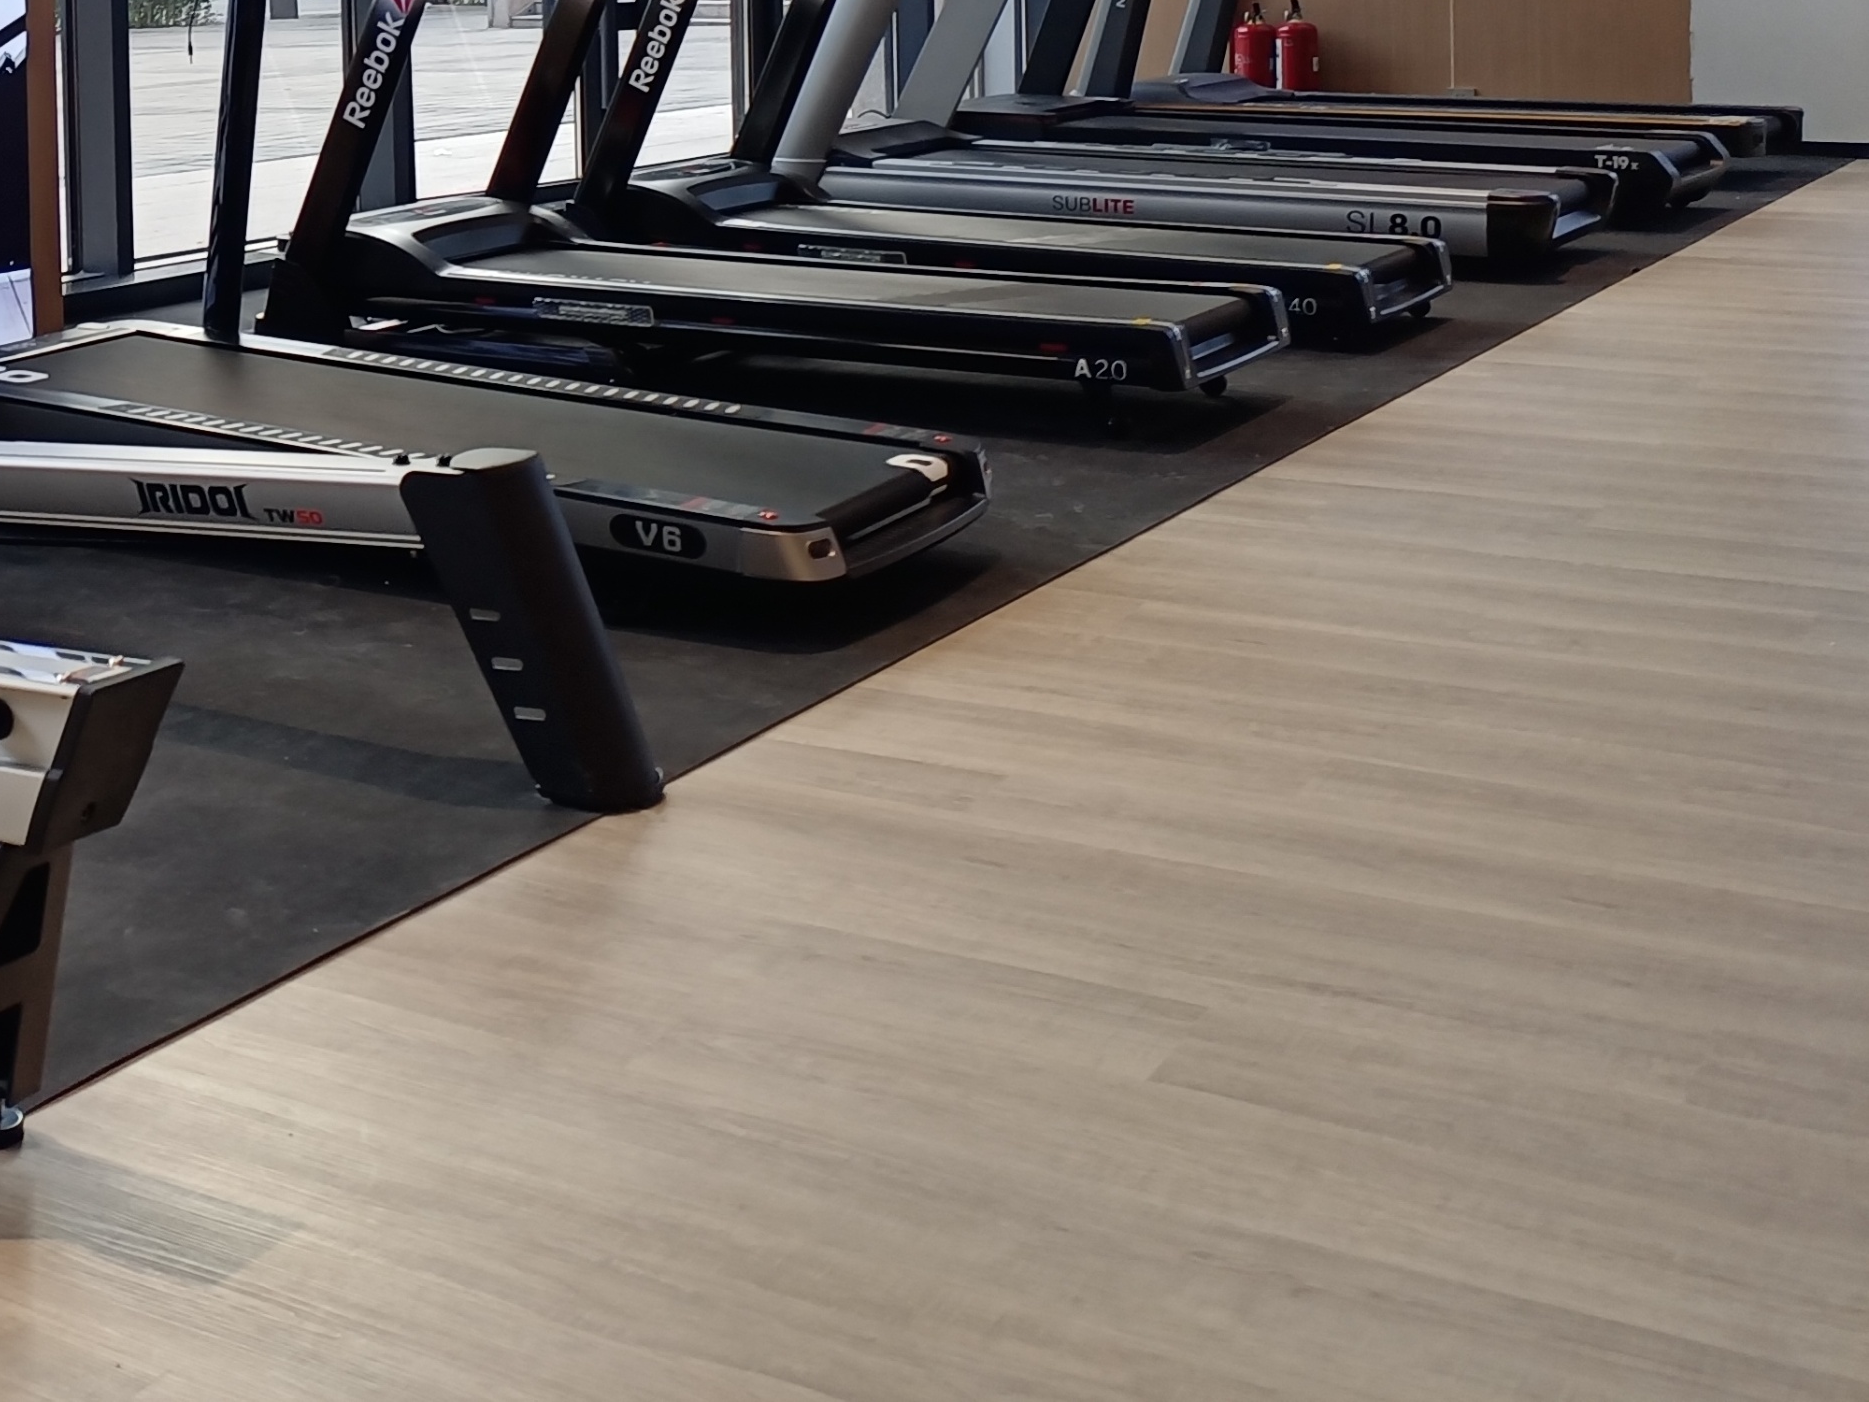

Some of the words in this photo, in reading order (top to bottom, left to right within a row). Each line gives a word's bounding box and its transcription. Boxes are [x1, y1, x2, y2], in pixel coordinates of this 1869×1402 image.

[342, 8, 407, 130] Reebok
[1052, 194, 1135, 215] SUBLITE
[634, 518, 682, 553] V6
